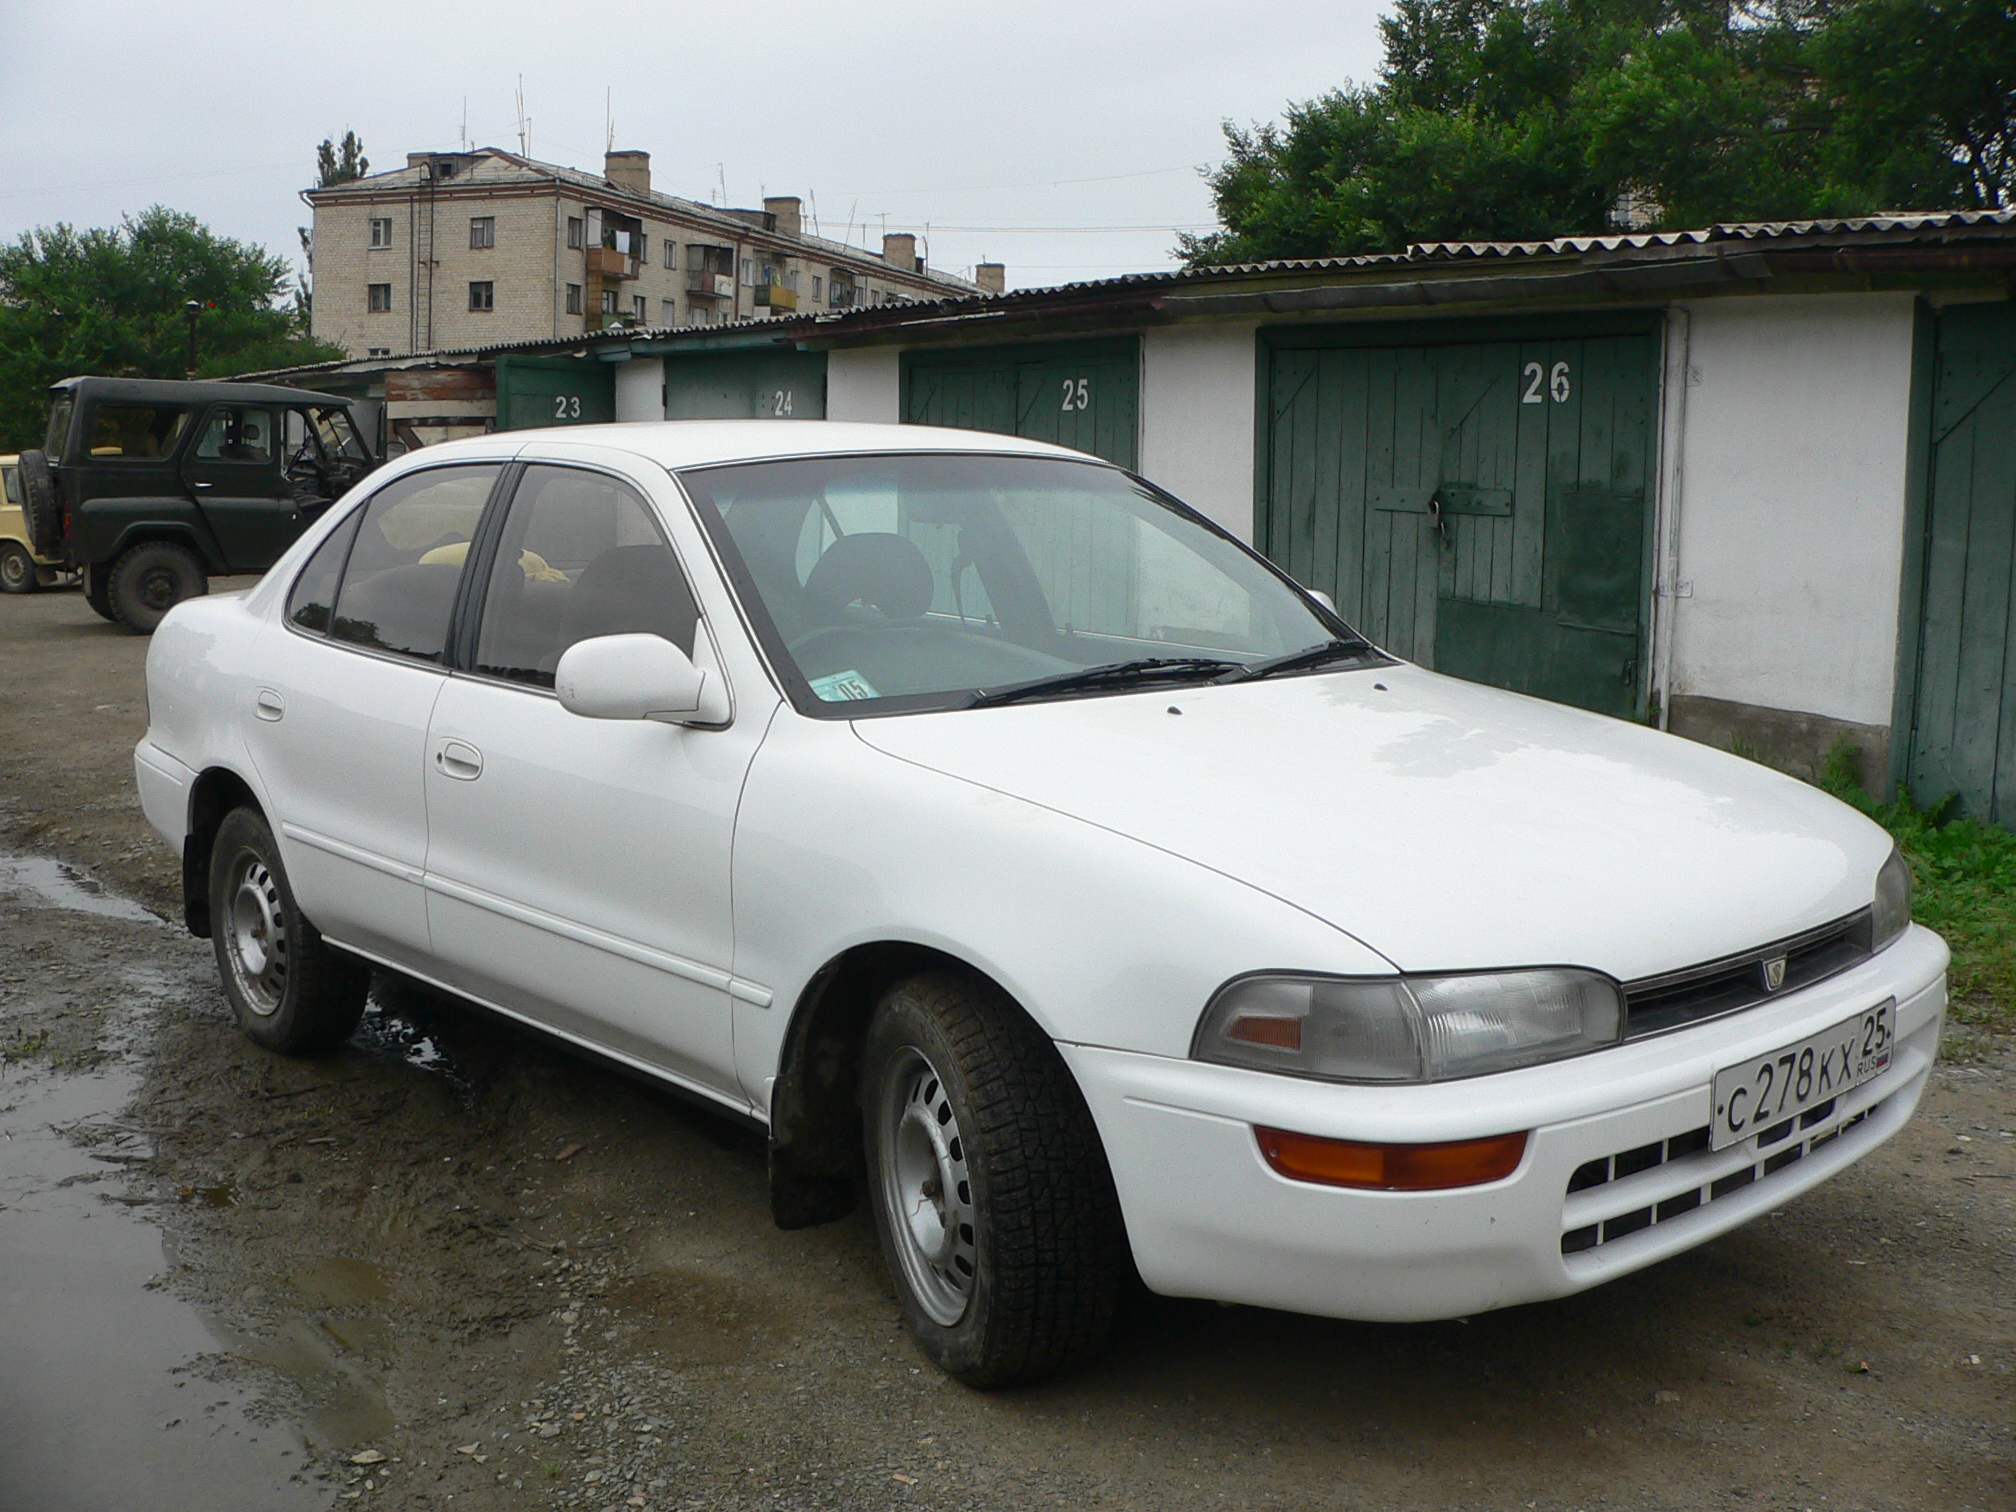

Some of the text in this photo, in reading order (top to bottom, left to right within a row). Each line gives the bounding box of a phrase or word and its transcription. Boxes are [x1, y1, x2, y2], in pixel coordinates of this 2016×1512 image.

[1062, 379, 1088, 410] 25
[1522, 361, 1570, 403] 26
[555, 395, 580, 418] 23
[775, 390, 792, 416] 24
[1862, 1006, 1887, 1057] 25
[1856, 1055, 1877, 1078] RUS
